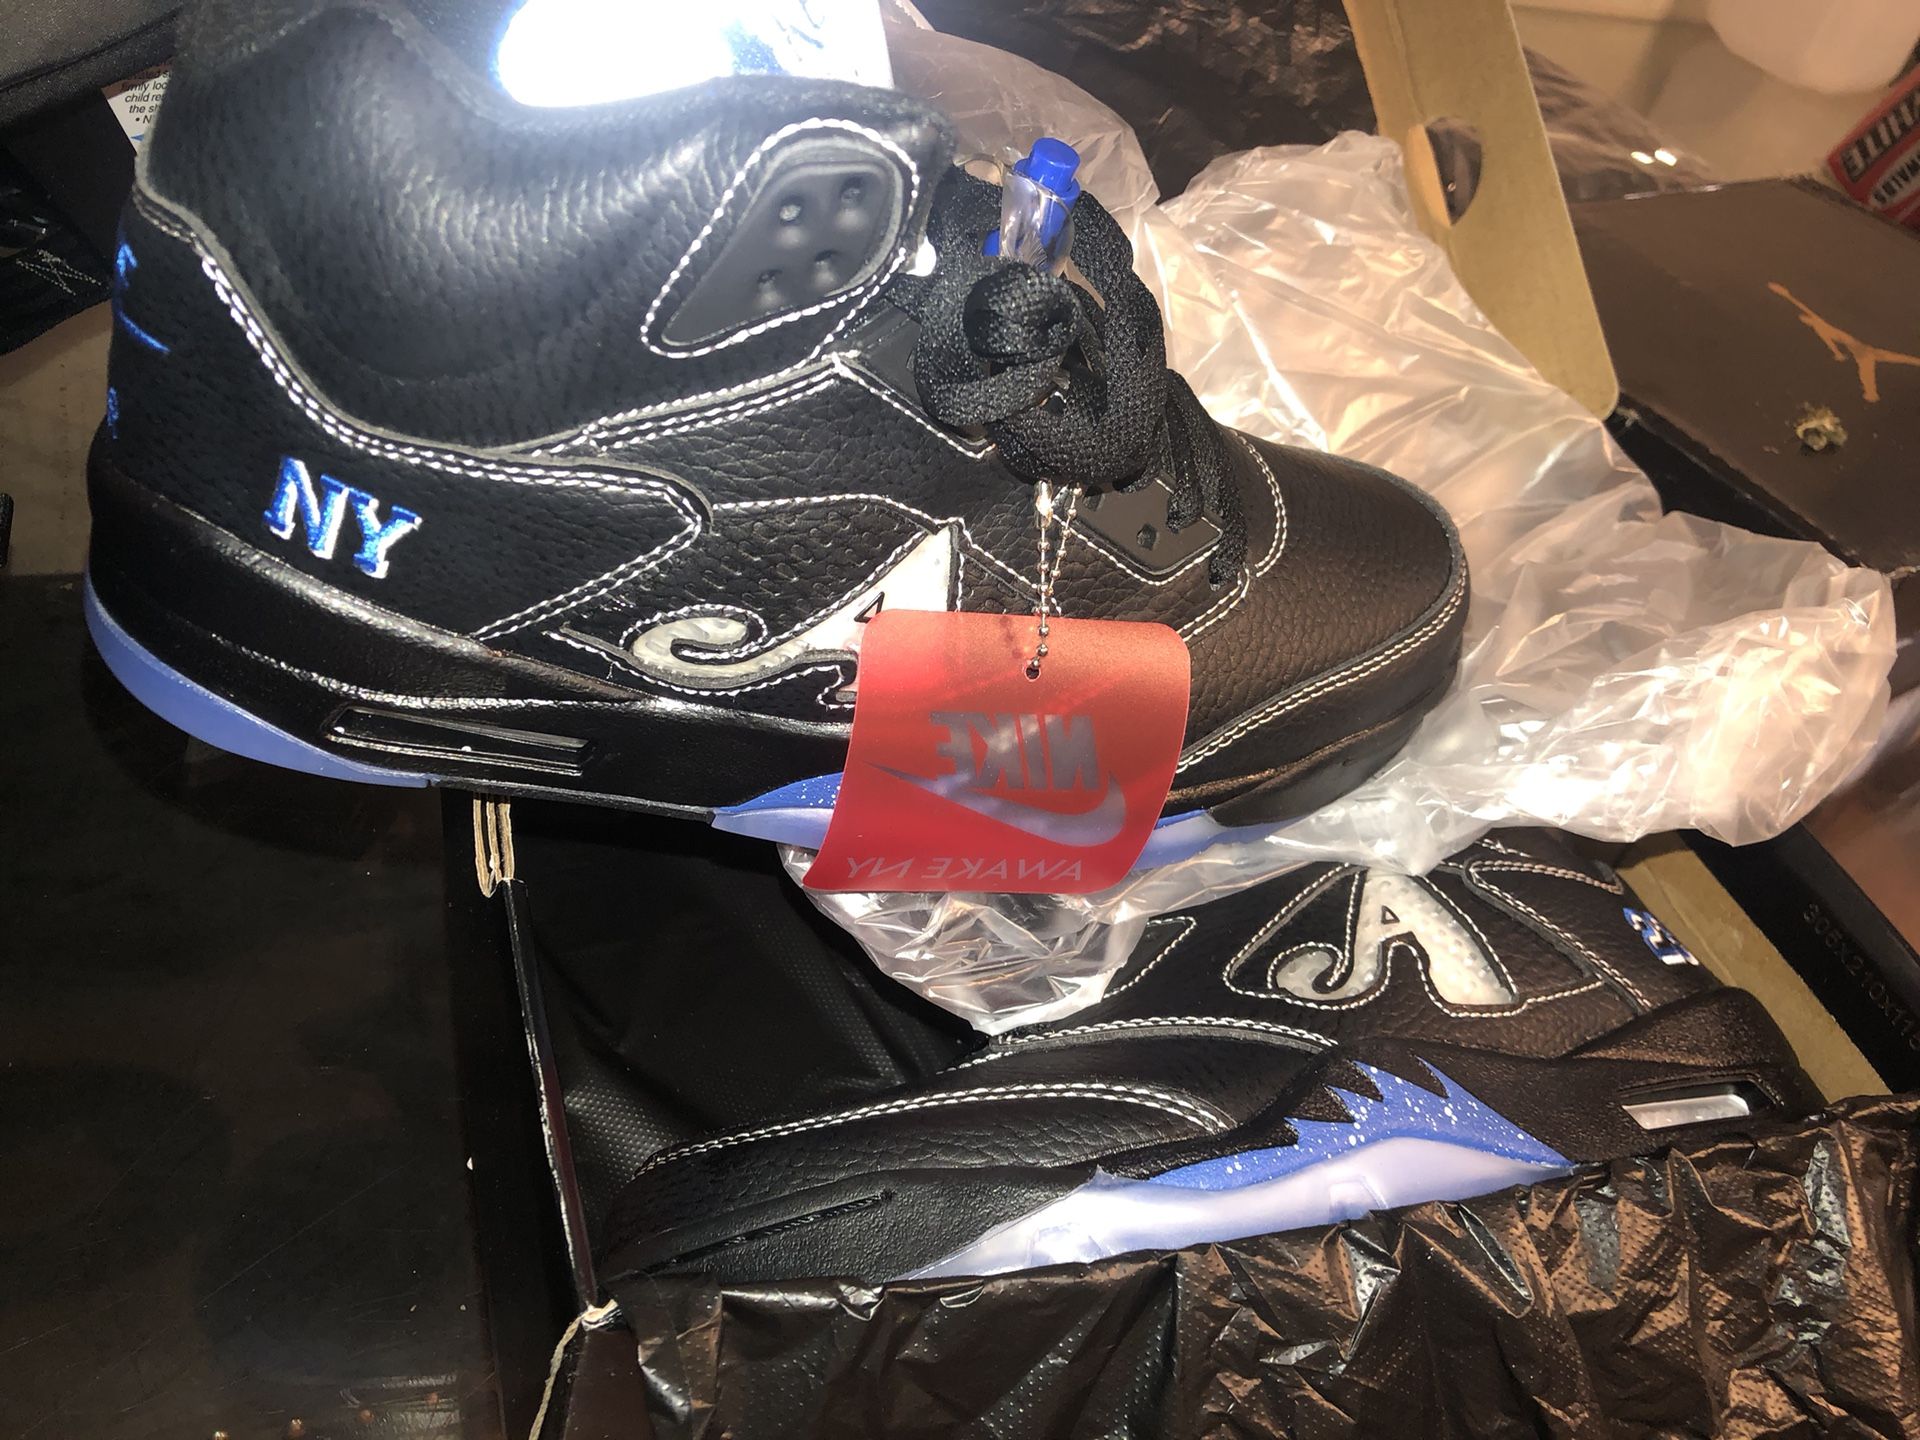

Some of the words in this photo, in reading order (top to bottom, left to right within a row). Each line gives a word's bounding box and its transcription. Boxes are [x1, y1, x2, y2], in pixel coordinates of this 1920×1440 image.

[124, 93, 151, 103] child
[129, 103, 146, 113] the
[263, 455, 422, 579] NY
